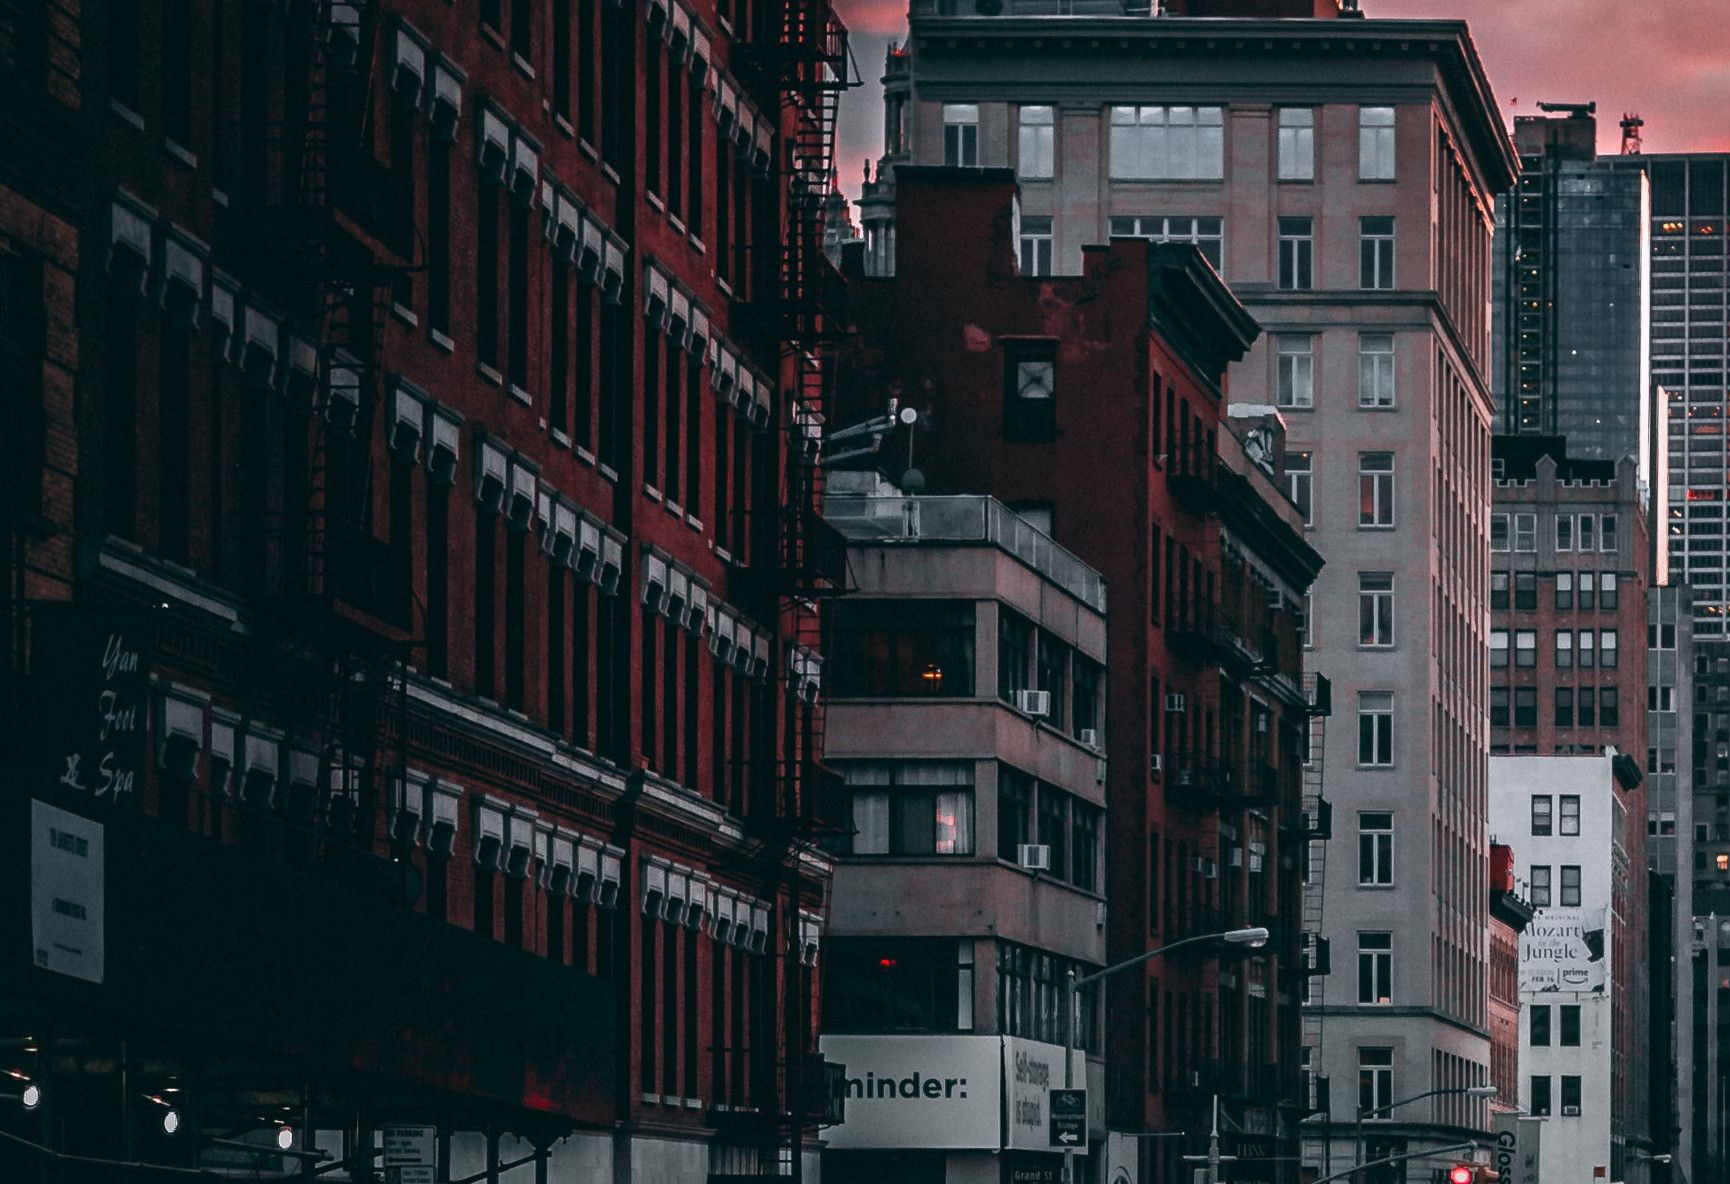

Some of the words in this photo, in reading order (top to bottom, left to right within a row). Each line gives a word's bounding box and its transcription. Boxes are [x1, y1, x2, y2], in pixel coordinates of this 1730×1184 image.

[102, 633, 139, 681] Yan
[94, 751, 135, 804] Spa
[1523, 943, 1578, 963] Jungle
[1563, 968, 1589, 977] prime
